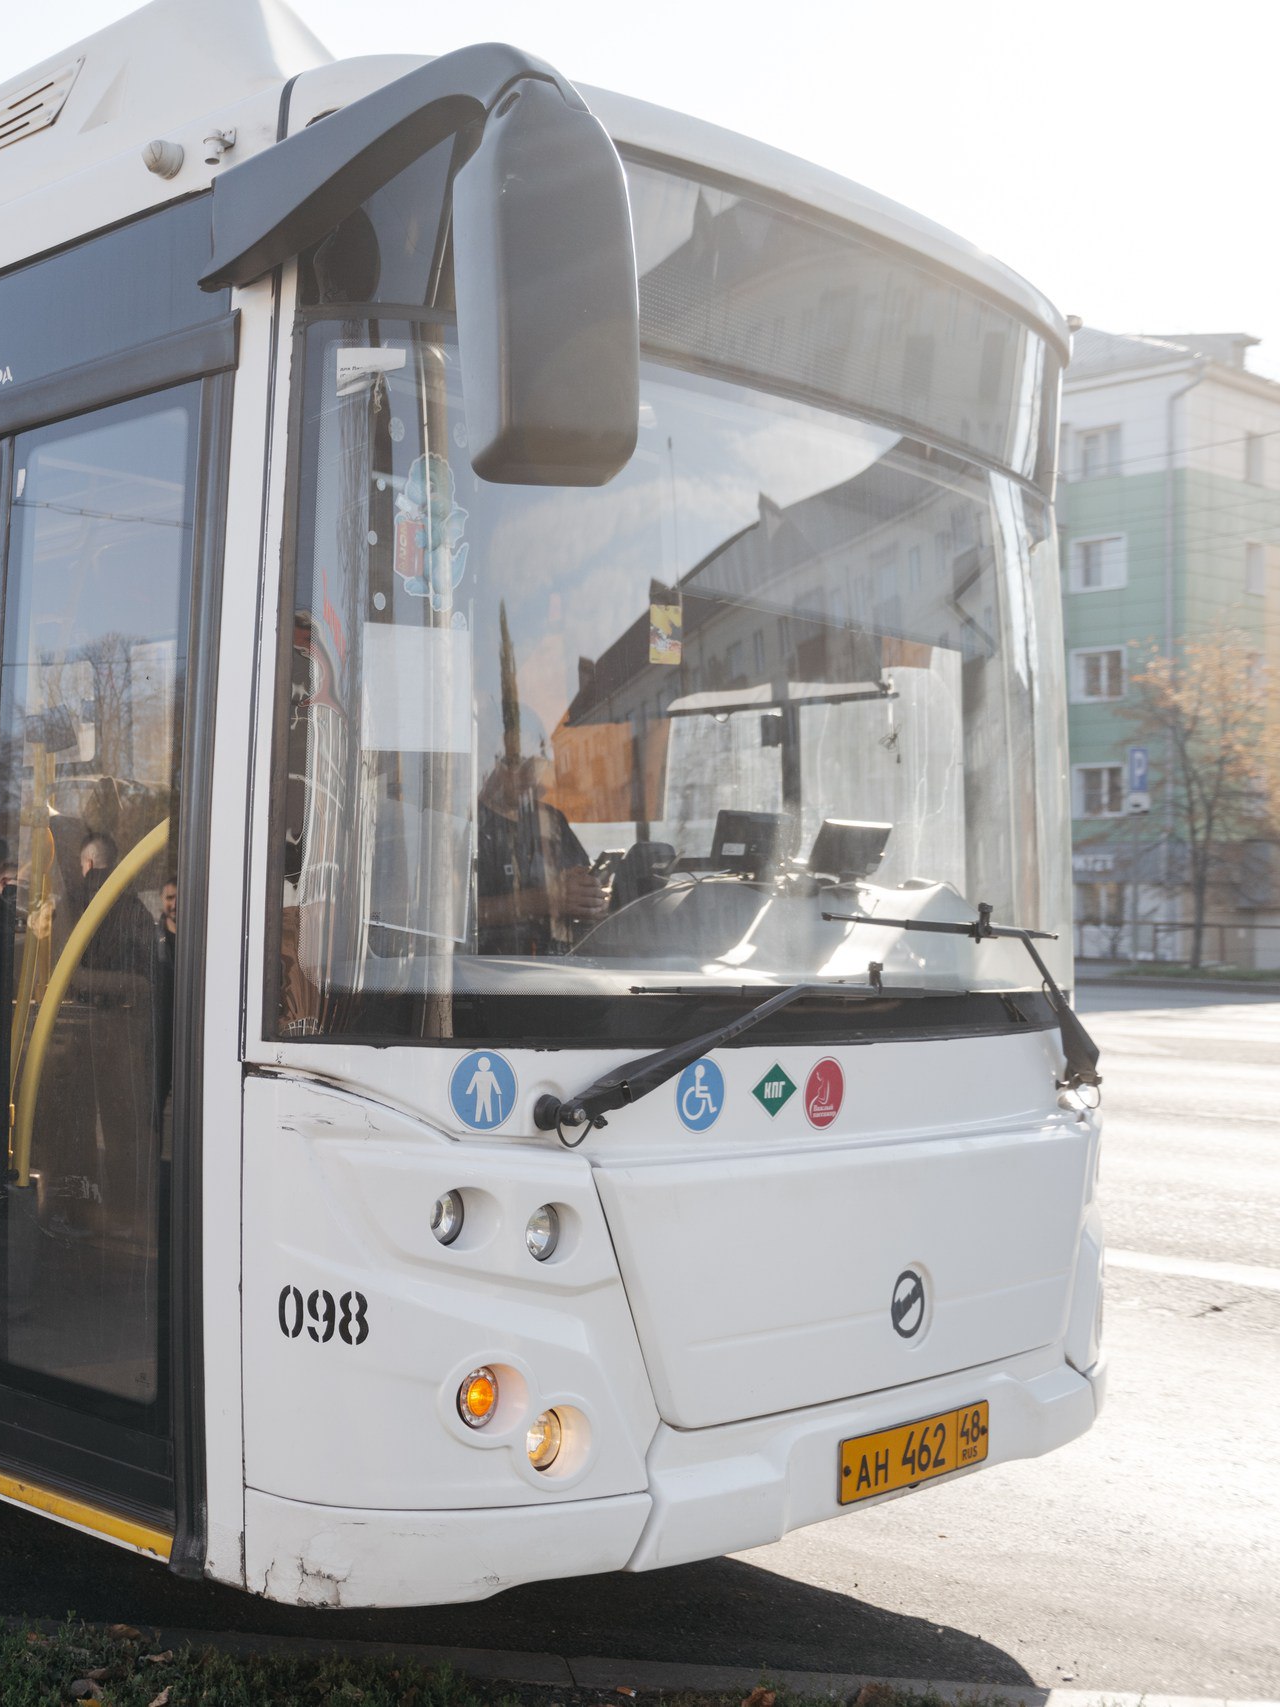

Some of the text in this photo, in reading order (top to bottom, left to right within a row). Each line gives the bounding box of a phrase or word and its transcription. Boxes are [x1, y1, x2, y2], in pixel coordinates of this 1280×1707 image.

[764, 1081, 786, 1099] КПГ
[278, 1284, 369, 1346] 098
[960, 1409, 981, 1446] 48
[856, 1422, 947, 1492] АН 462
[961, 1445, 978, 1461] RUS
